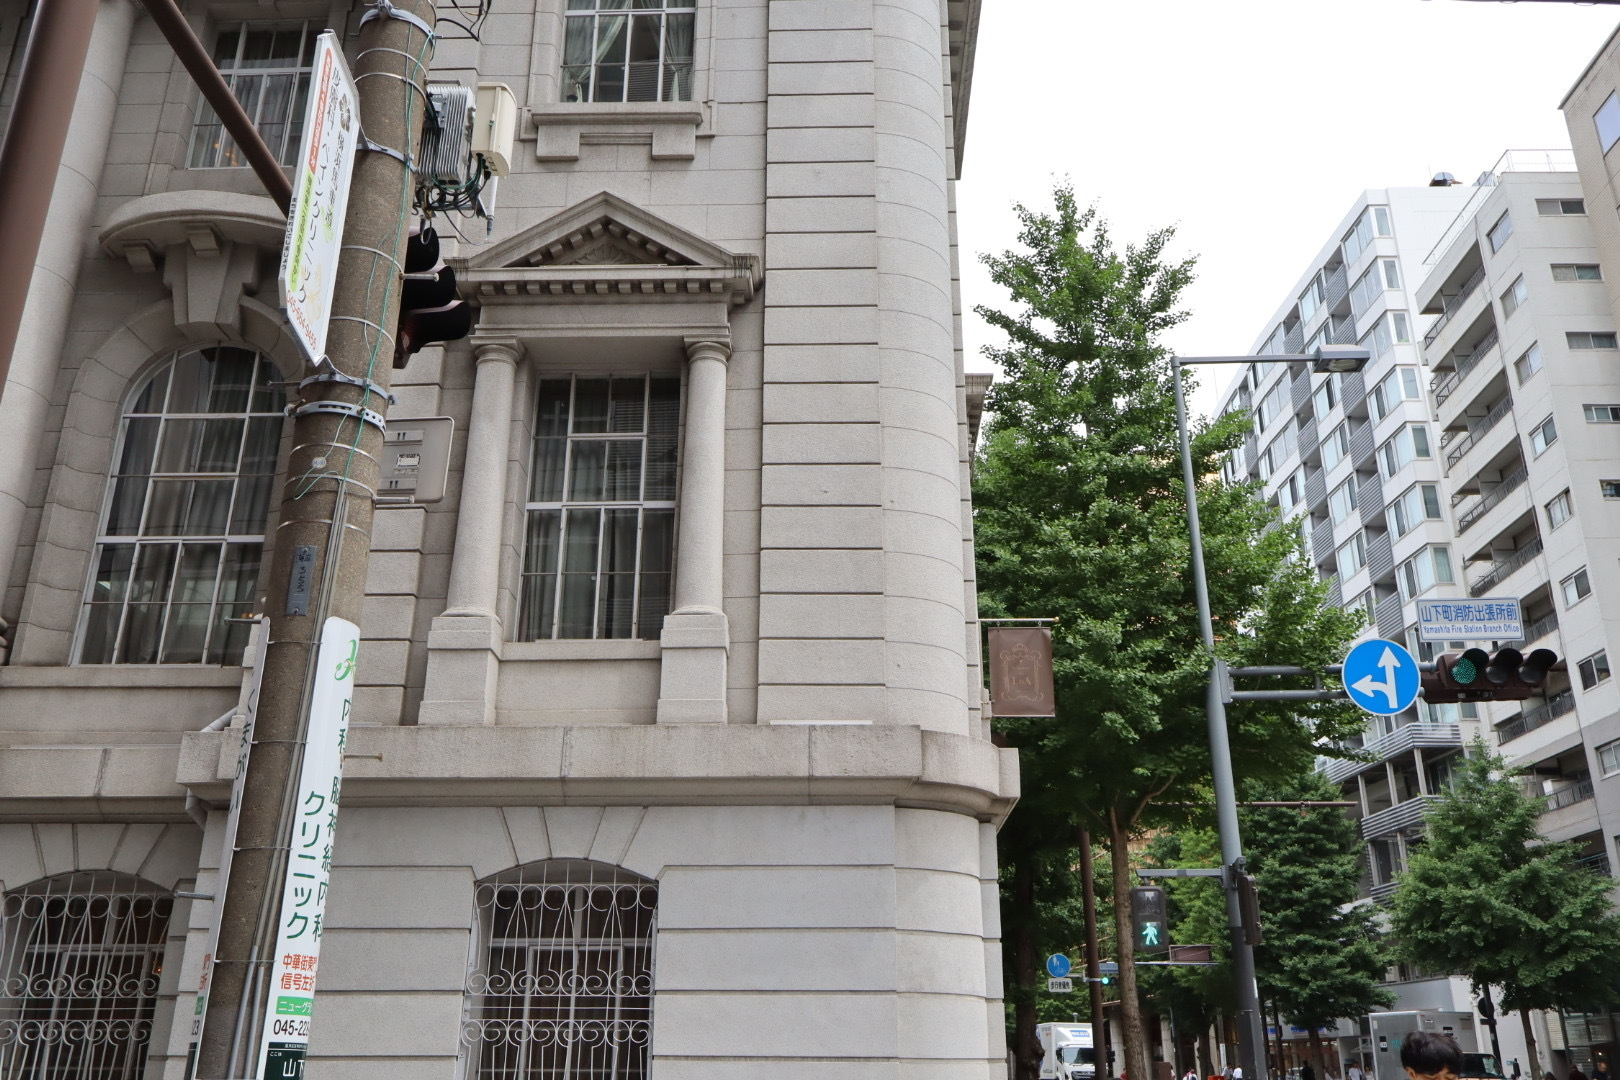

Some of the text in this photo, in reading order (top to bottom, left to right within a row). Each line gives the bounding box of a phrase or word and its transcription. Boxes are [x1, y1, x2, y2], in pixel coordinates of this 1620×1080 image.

[1421, 602, 1517, 622] 山下町消防出張所前
[1423, 623, 1519, 634] Yamashita Fire Station Branch Office
[286, 790, 325, 940] クリニック
